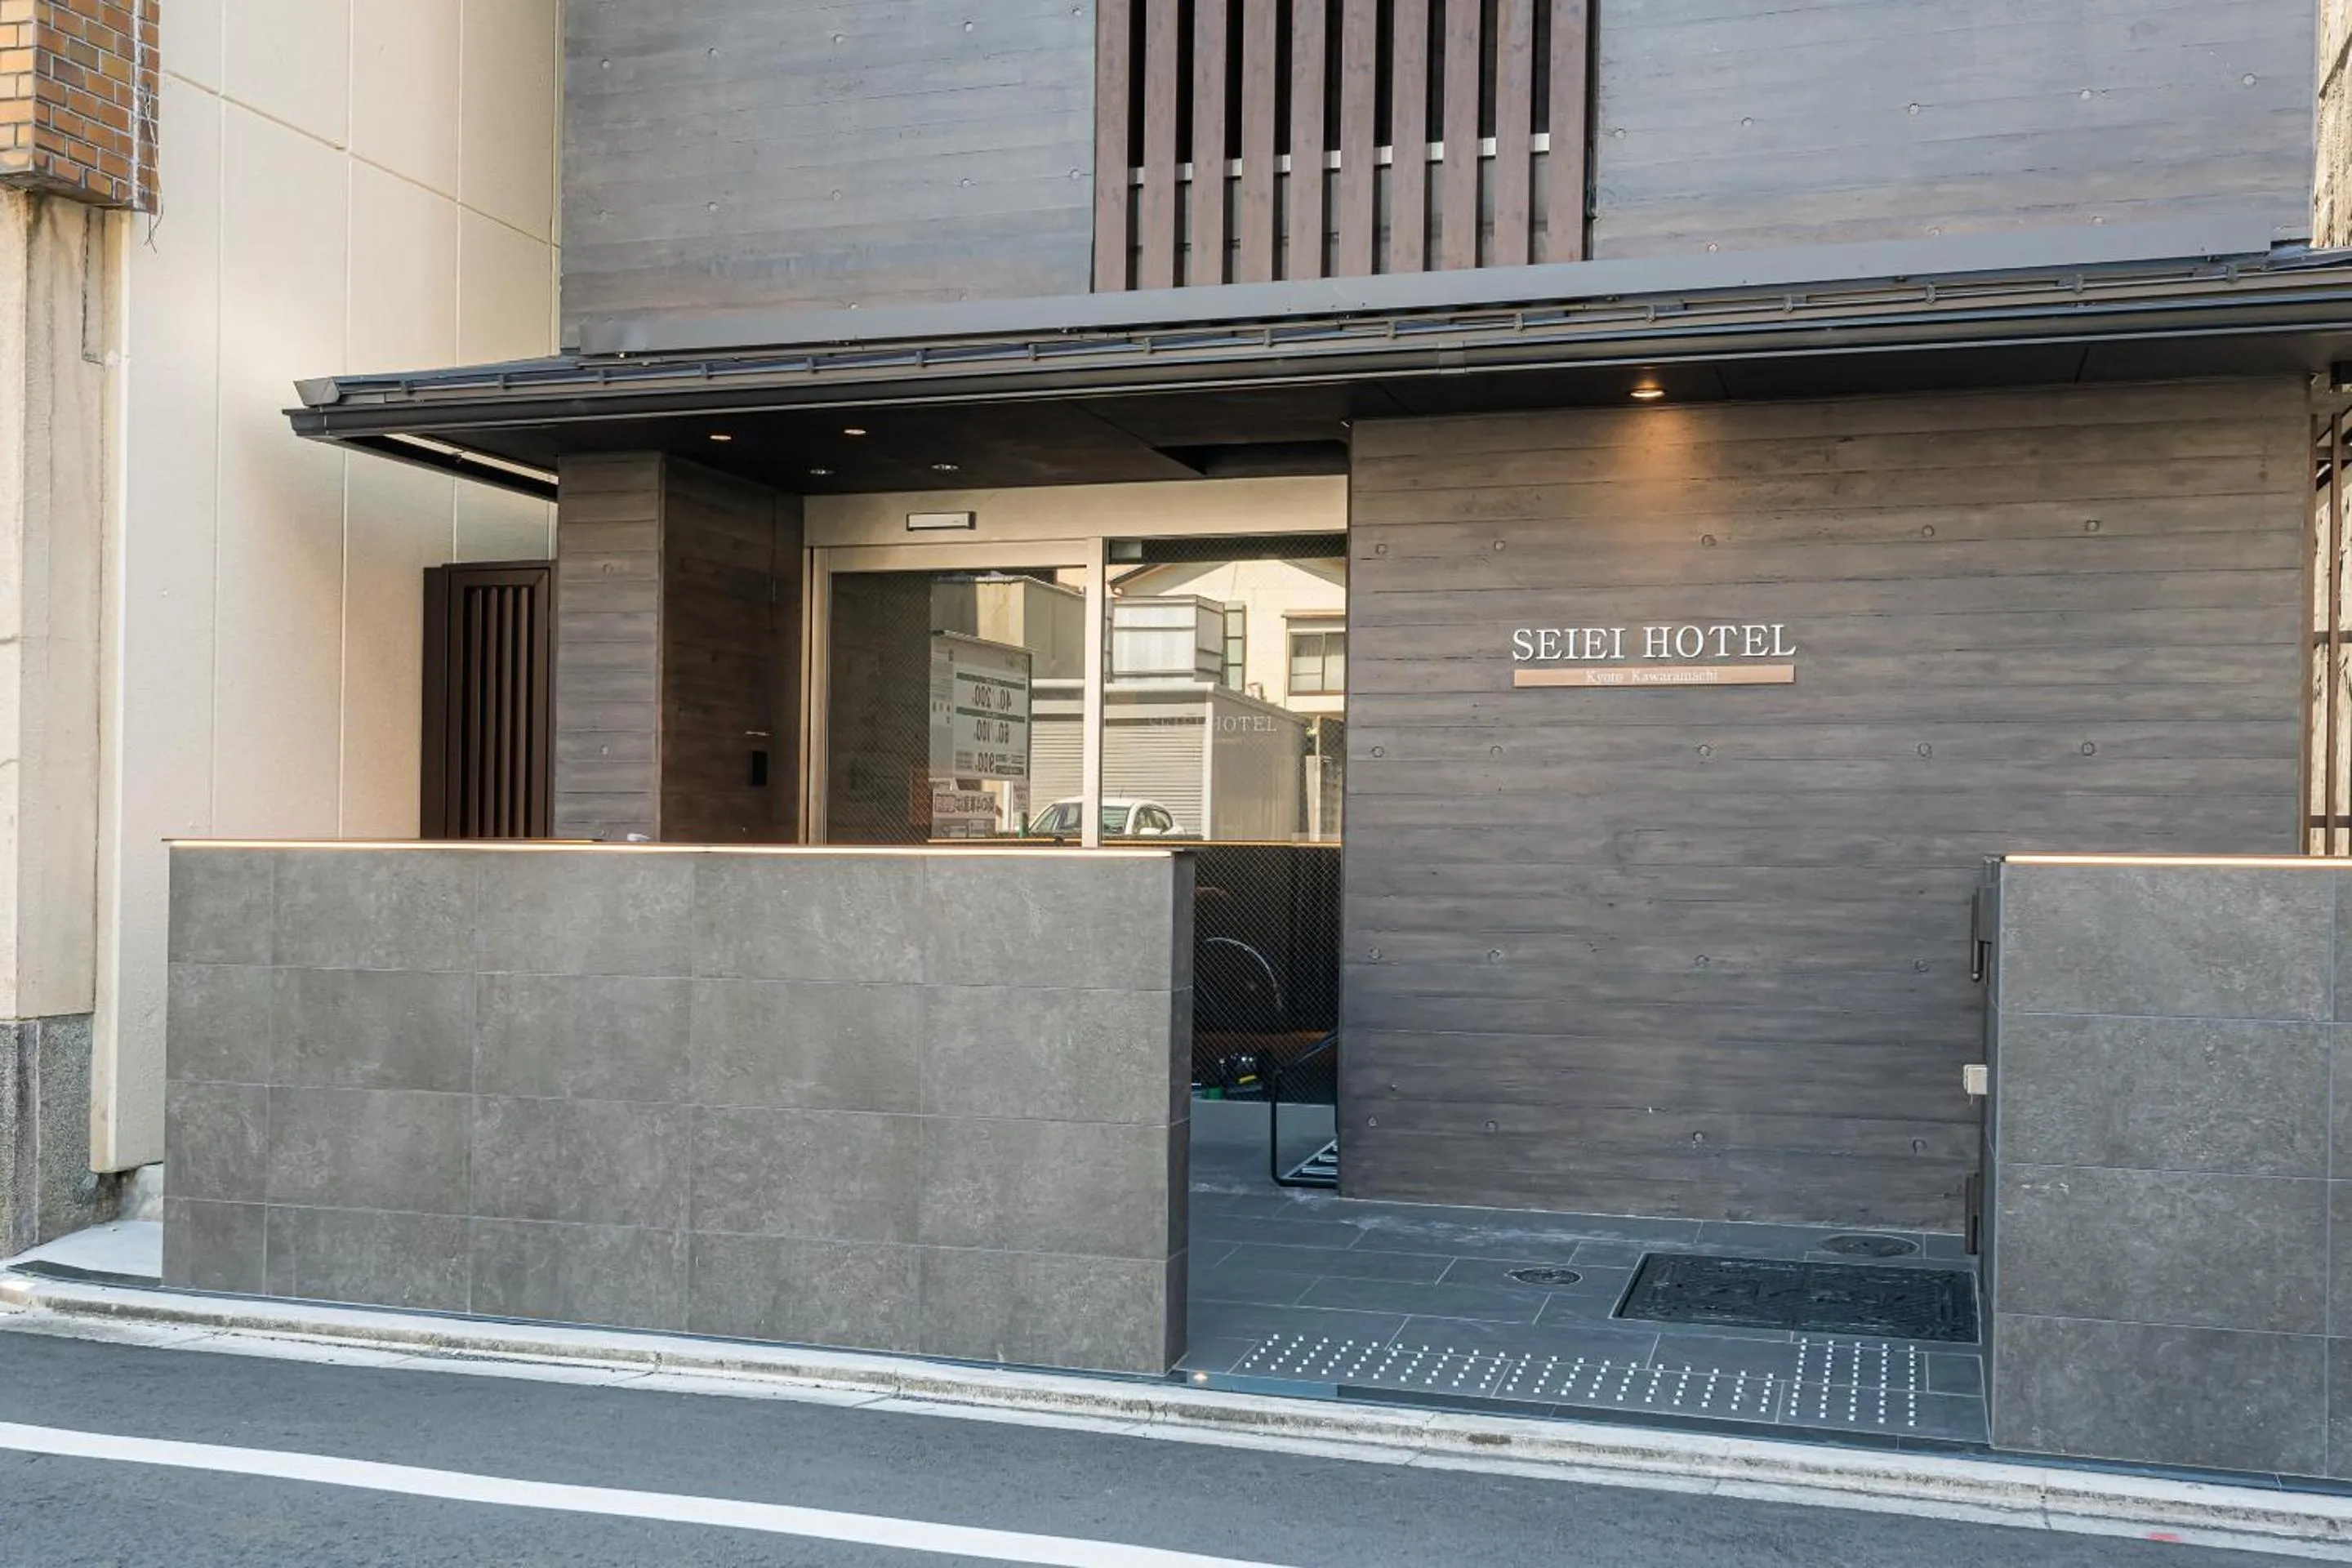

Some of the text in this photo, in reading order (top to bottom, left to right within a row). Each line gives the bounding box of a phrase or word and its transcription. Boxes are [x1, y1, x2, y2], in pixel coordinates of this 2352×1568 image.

[1512, 625, 1797, 661] SEIEI HOTEL
[1586, 669, 1718, 684] Kyoto Kawaramachi
